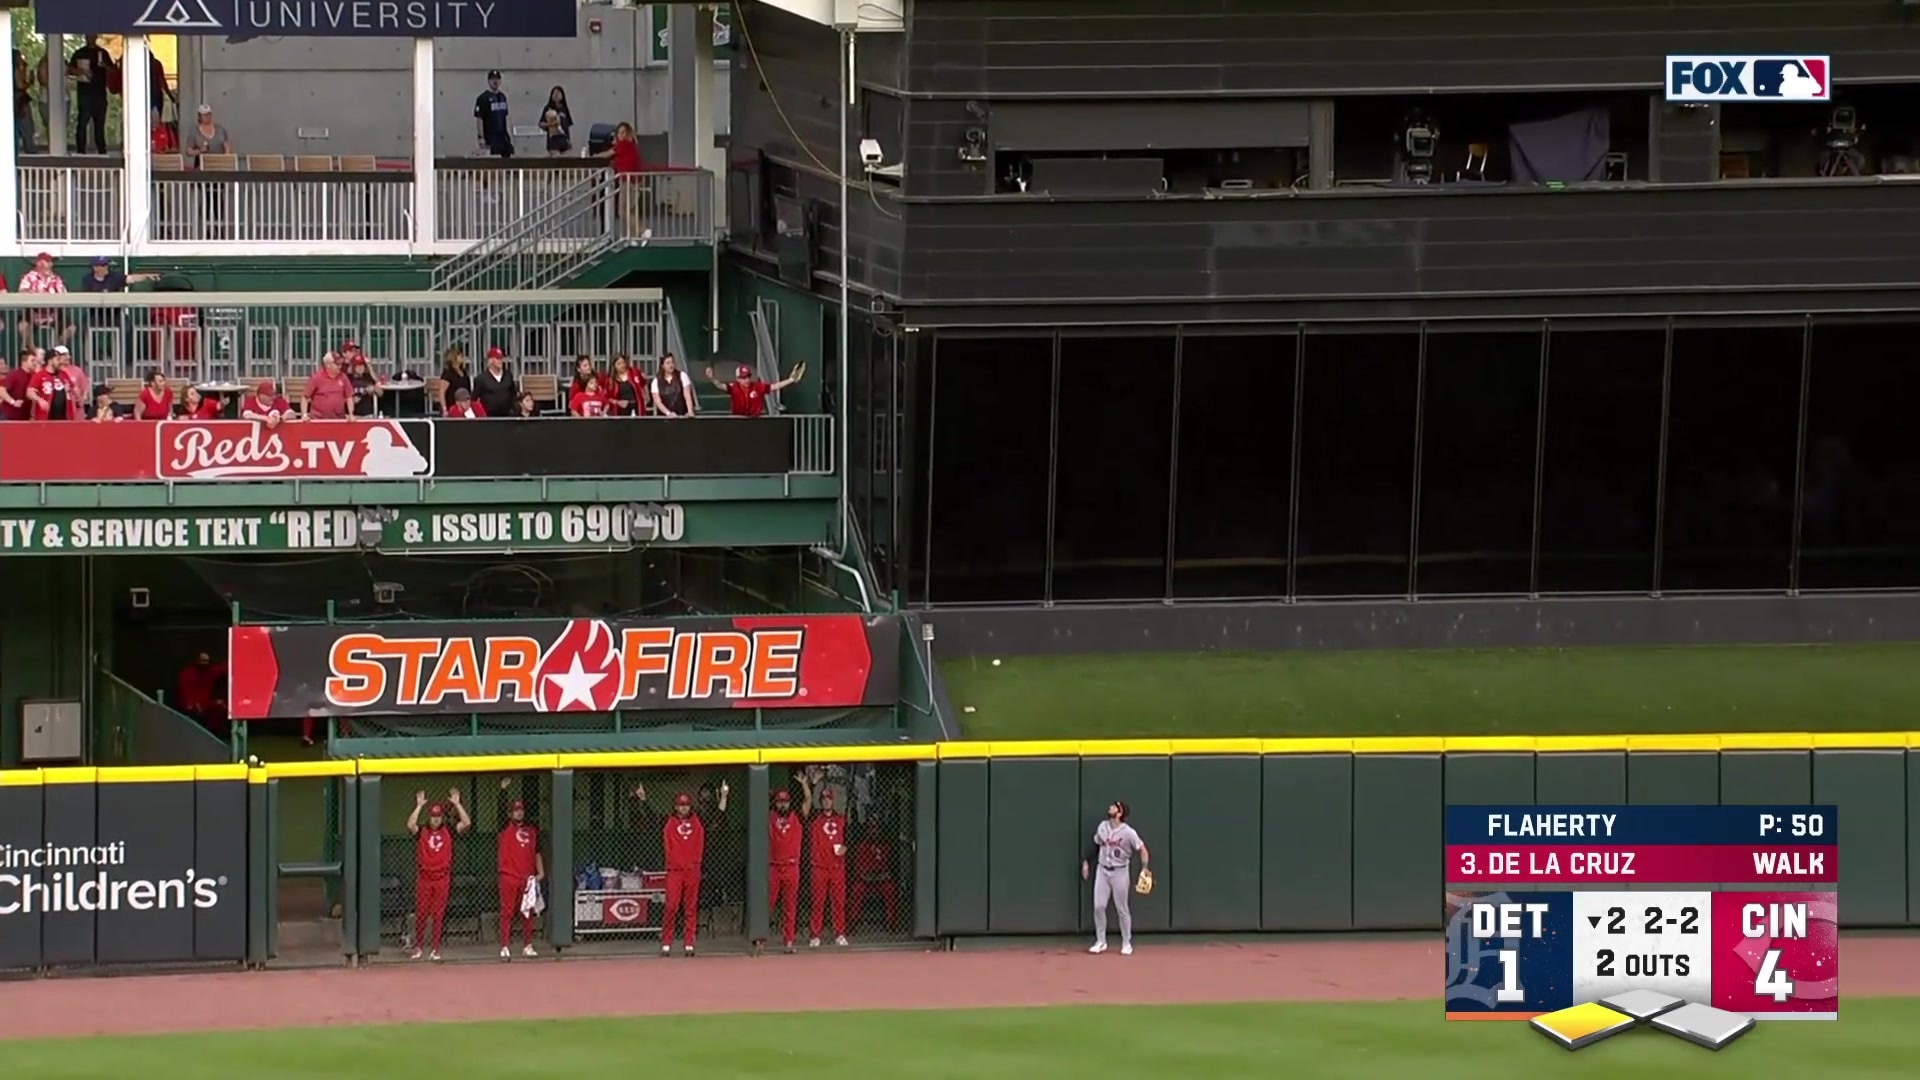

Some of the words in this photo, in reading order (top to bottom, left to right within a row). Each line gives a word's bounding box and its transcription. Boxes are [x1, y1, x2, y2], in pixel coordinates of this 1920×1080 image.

[250, 1, 496, 28] UNIVERSITY
[43, 524, 63, 547] &
[71, 518, 188, 547] SERVICE
[196, 518, 261, 546] TEXT
[404, 518, 423, 543] &
[432, 514, 512, 542] ISSUE
[519, 511, 552, 540] TO
[561, 503, 684, 543] 6900
[325, 633, 542, 706] STAR
[619, 627, 803, 700] FIRE
[0, 841, 125, 868] incinnati
